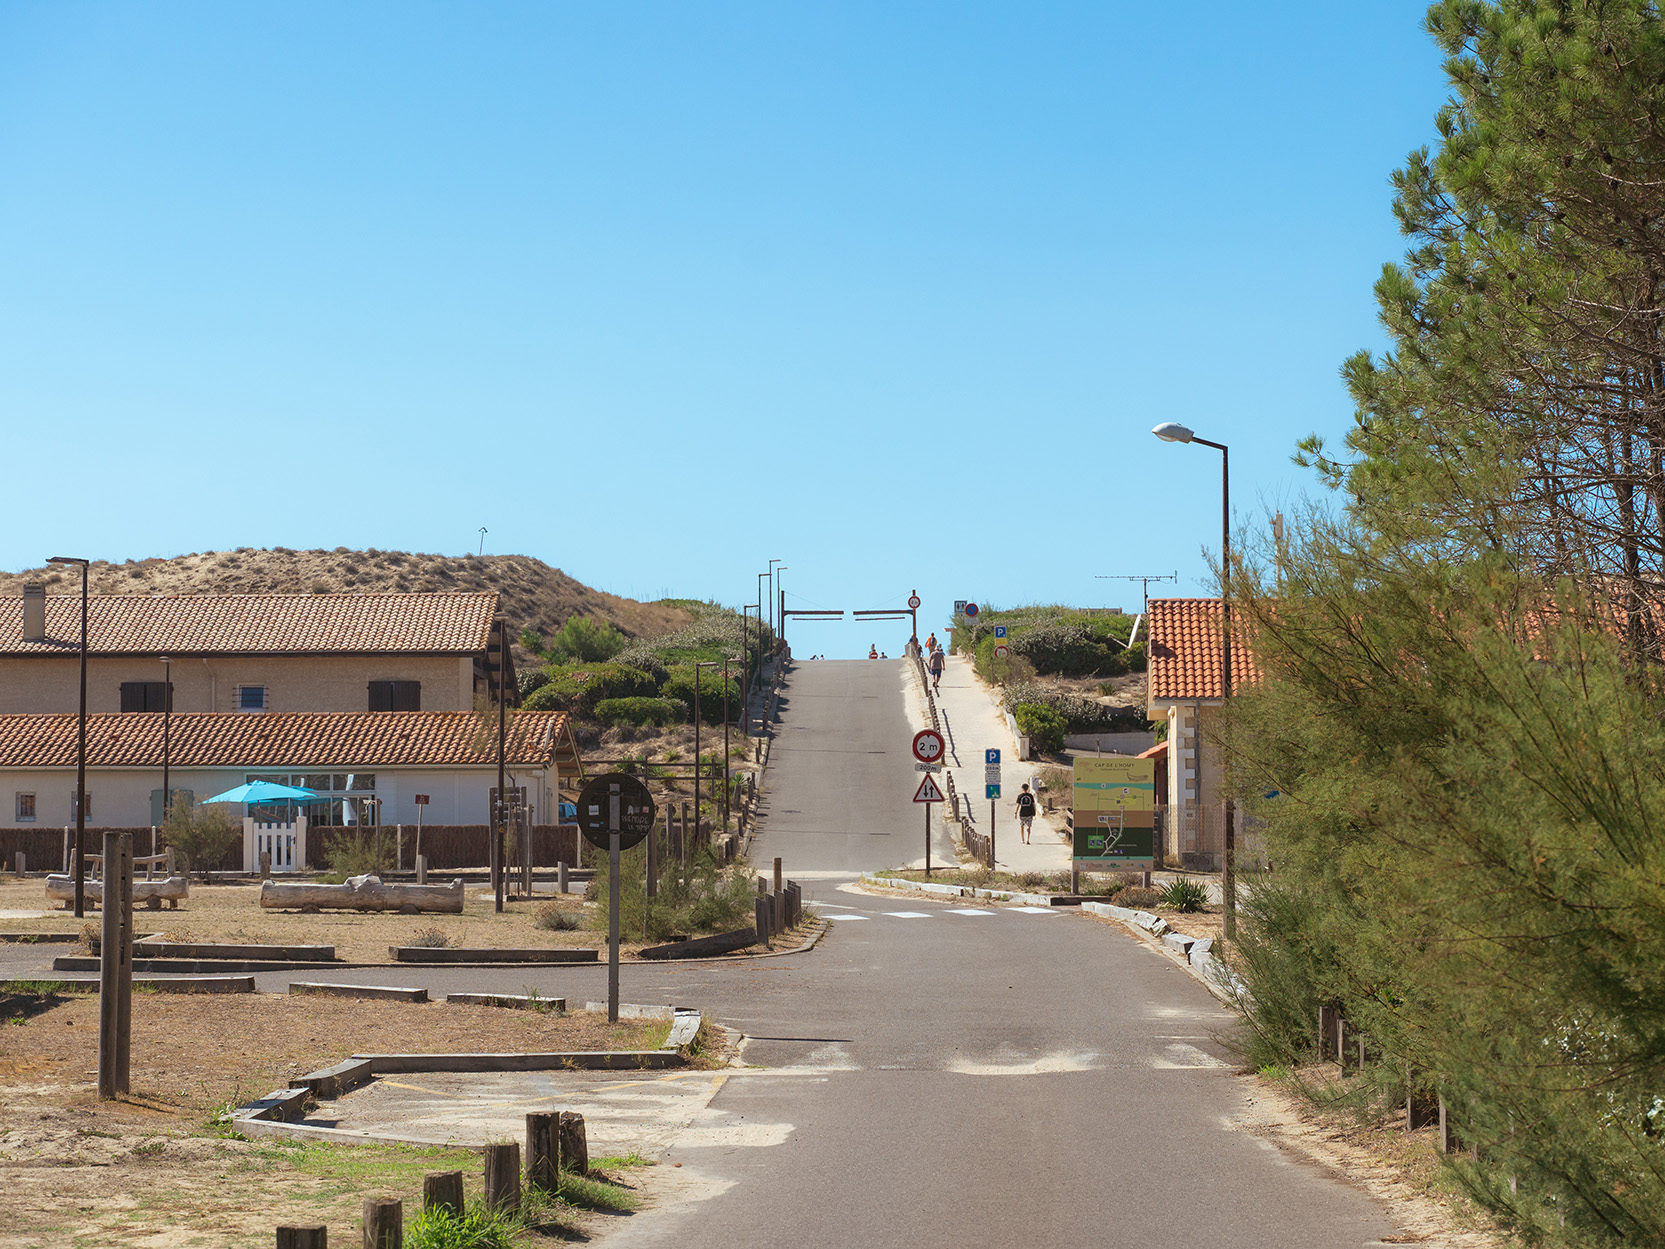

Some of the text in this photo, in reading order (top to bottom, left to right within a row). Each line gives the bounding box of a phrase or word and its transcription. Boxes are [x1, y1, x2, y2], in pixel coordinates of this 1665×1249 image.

[998, 628, 1003, 636] P
[919, 742, 925, 751] 2
[989, 752, 997, 762] P
[919, 764, 937, 772] 200m
